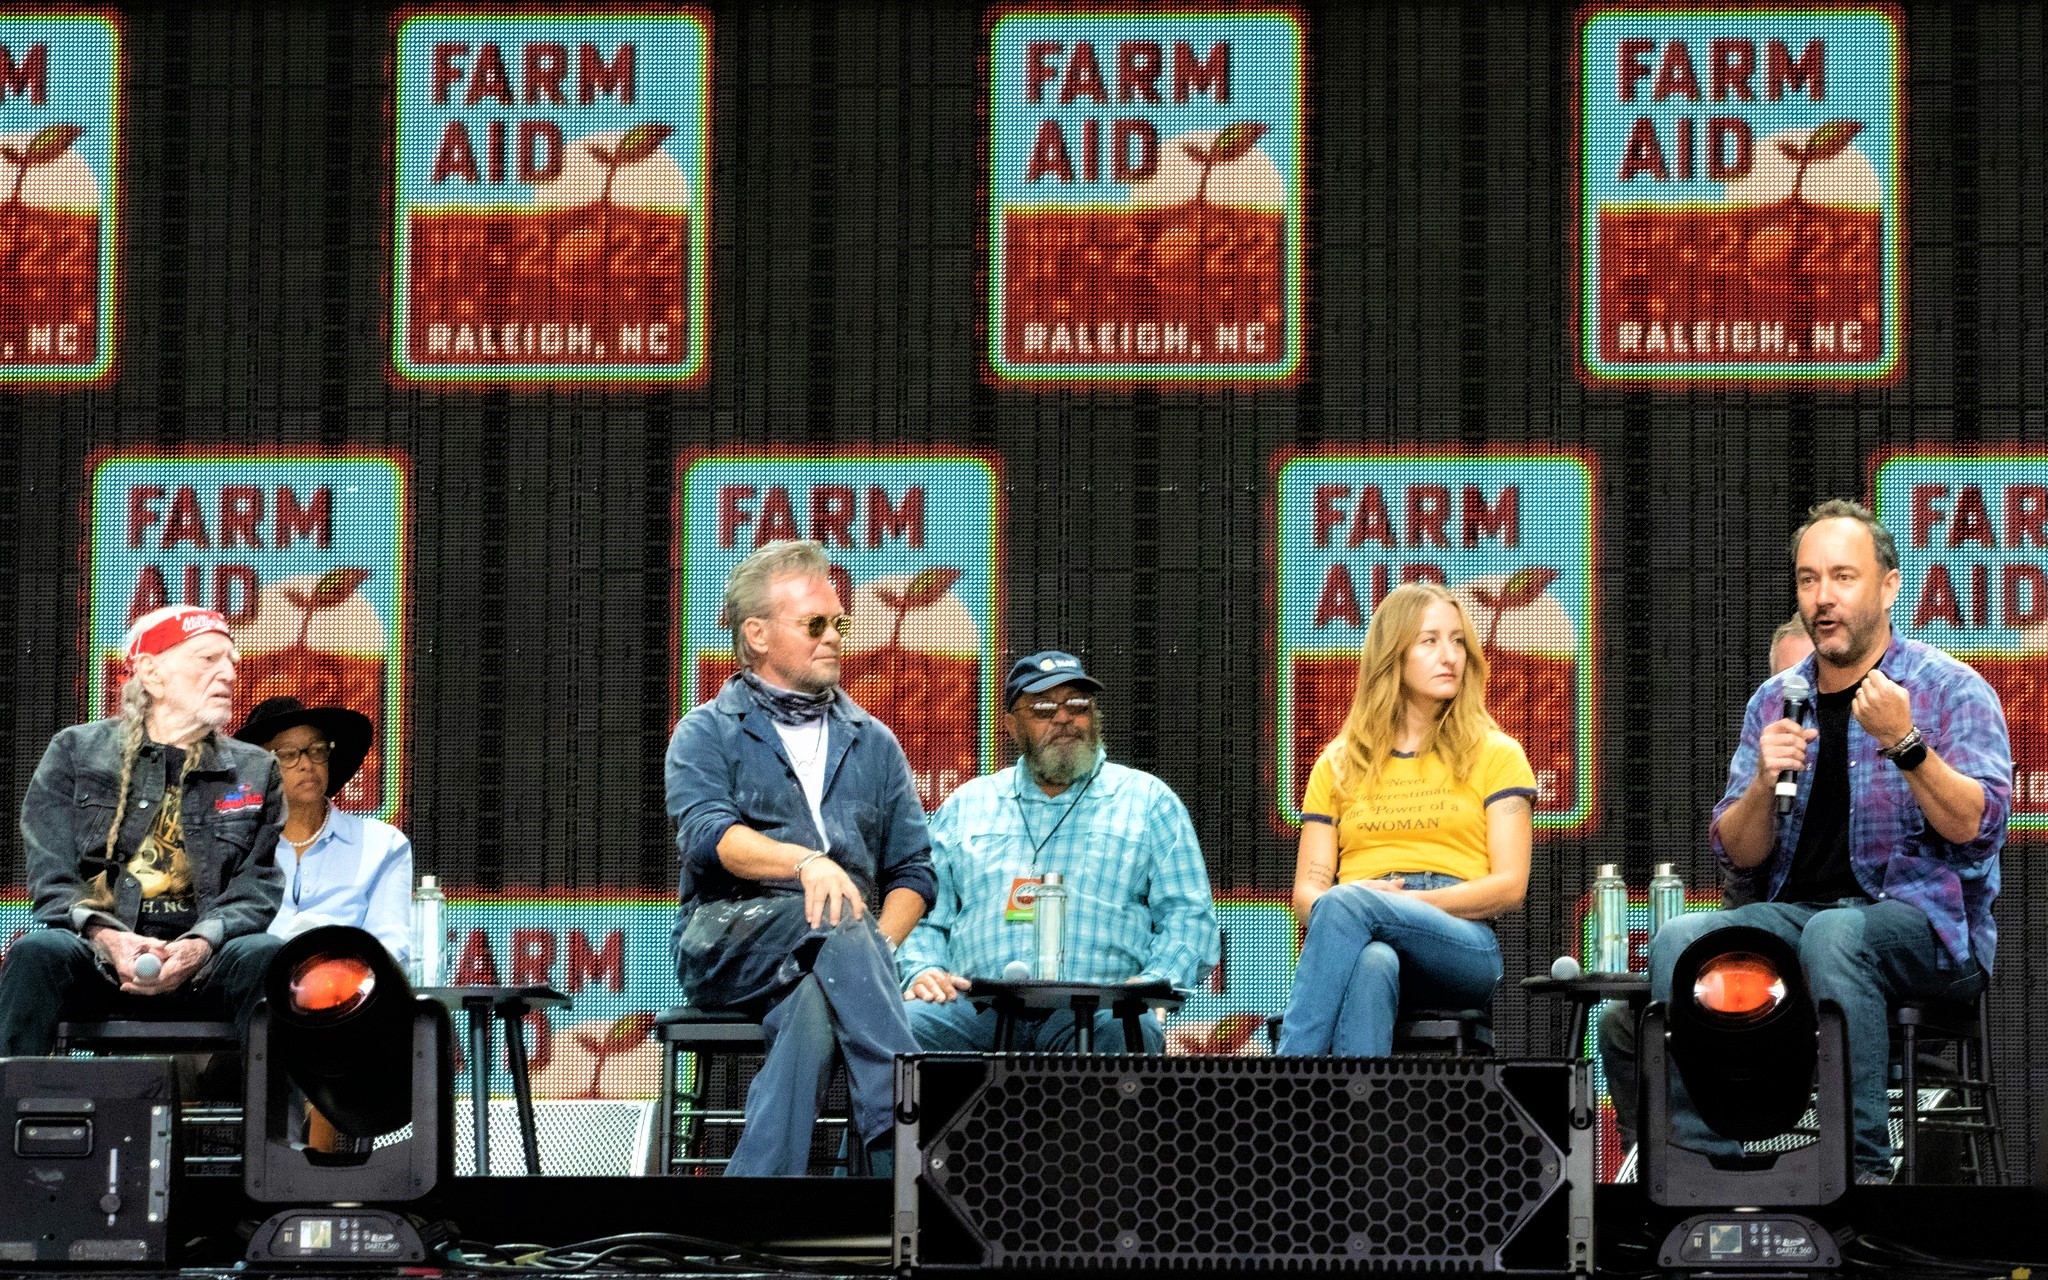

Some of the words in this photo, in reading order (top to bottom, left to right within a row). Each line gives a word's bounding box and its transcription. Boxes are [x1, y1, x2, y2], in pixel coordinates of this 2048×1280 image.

[431, 42, 637, 106] FARM
[1025, 41, 1231, 105] FARM
[1619, 38, 1825, 102] FARM
[431, 120, 564, 185] AID
[1025, 119, 1158, 184] AID
[1619, 116, 1752, 181] AID
[29, 323, 78, 355] NC
[428, 322, 606, 358] RALEIGH,
[619, 322, 670, 355] NC
[1024, 322, 1202, 358] RALEIGH,
[1215, 322, 1266, 355] NC
[1618, 320, 1796, 356] RALEIGH,
[1809, 320, 1860, 353] NC
[127, 485, 333, 549] FARM
[719, 484, 925, 548] FARM
[1314, 485, 1520, 549] FARM
[1911, 484, 2048, 548] FAR
[127, 563, 260, 627] AID
[1912, 563, 2047, 629] AID
[1357, 817, 1440, 832] WOMAN
[1371, 804, 1425, 816] Power
[1430, 800, 1445, 811] of
[1451, 804, 1459, 812] a
[446, 927, 626, 994] ARM
